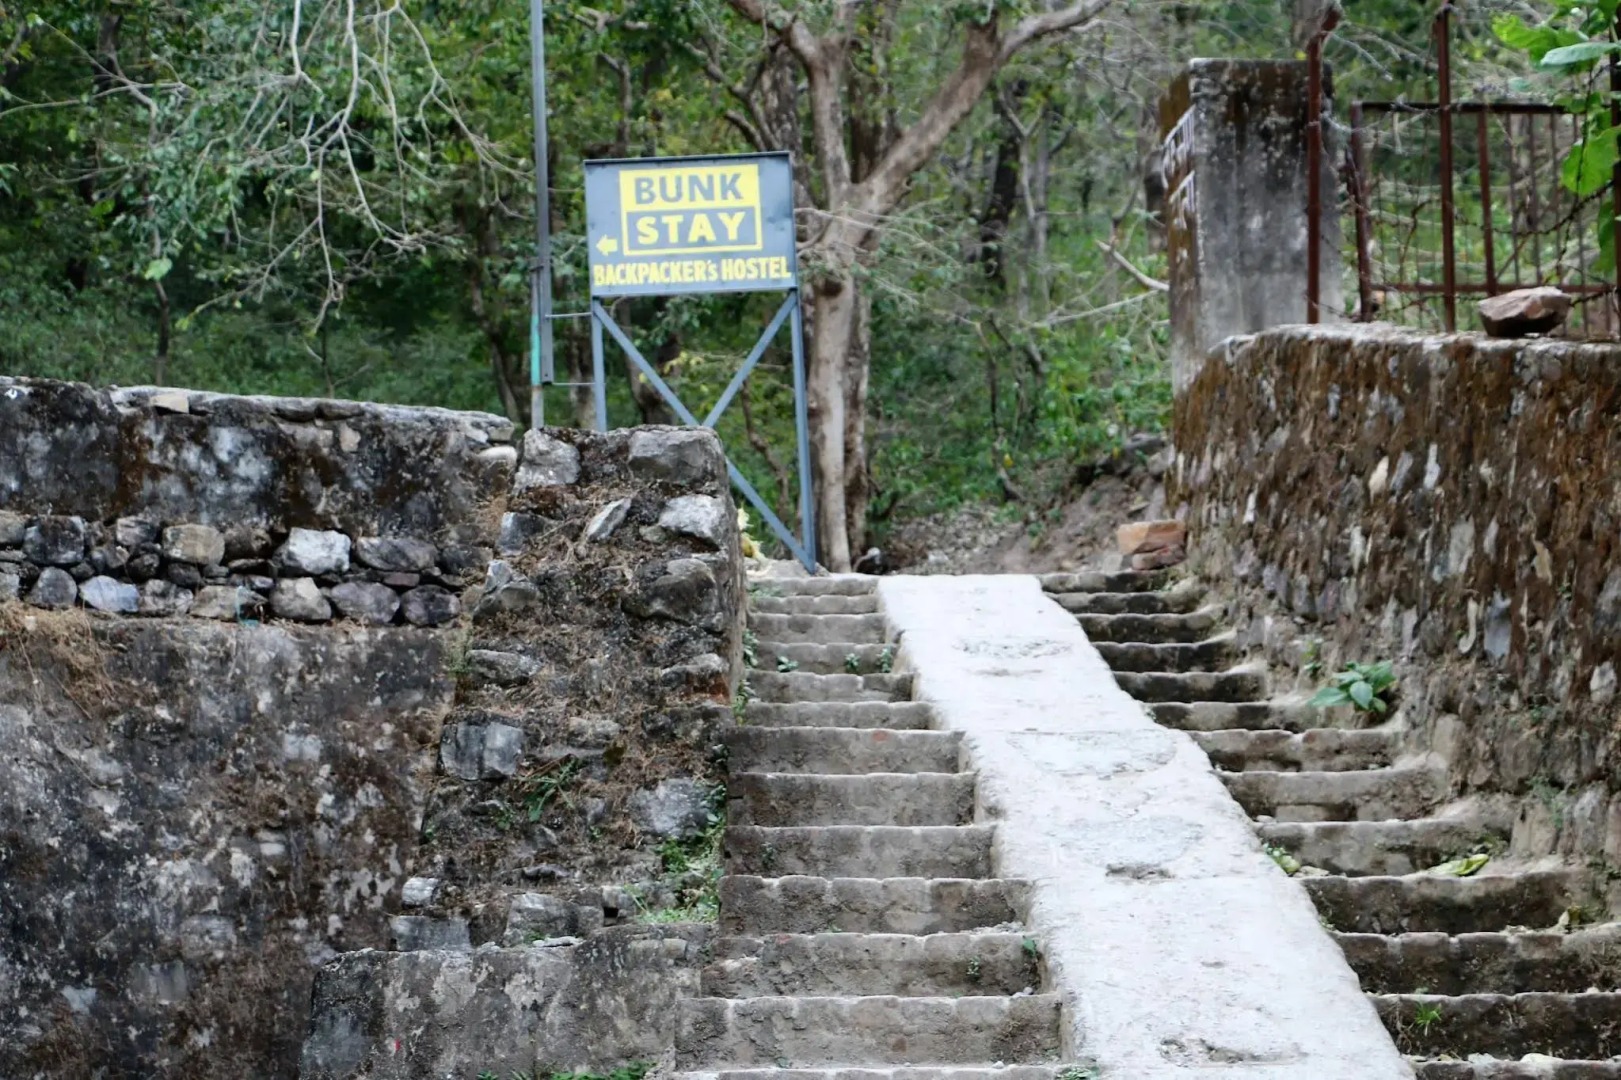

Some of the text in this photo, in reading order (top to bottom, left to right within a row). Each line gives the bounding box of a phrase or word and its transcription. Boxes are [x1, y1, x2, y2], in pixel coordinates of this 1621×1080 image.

[635, 173, 743, 205] BUNK
[636, 211, 746, 245] STAY
[721, 256, 792, 281] HOSTEL
